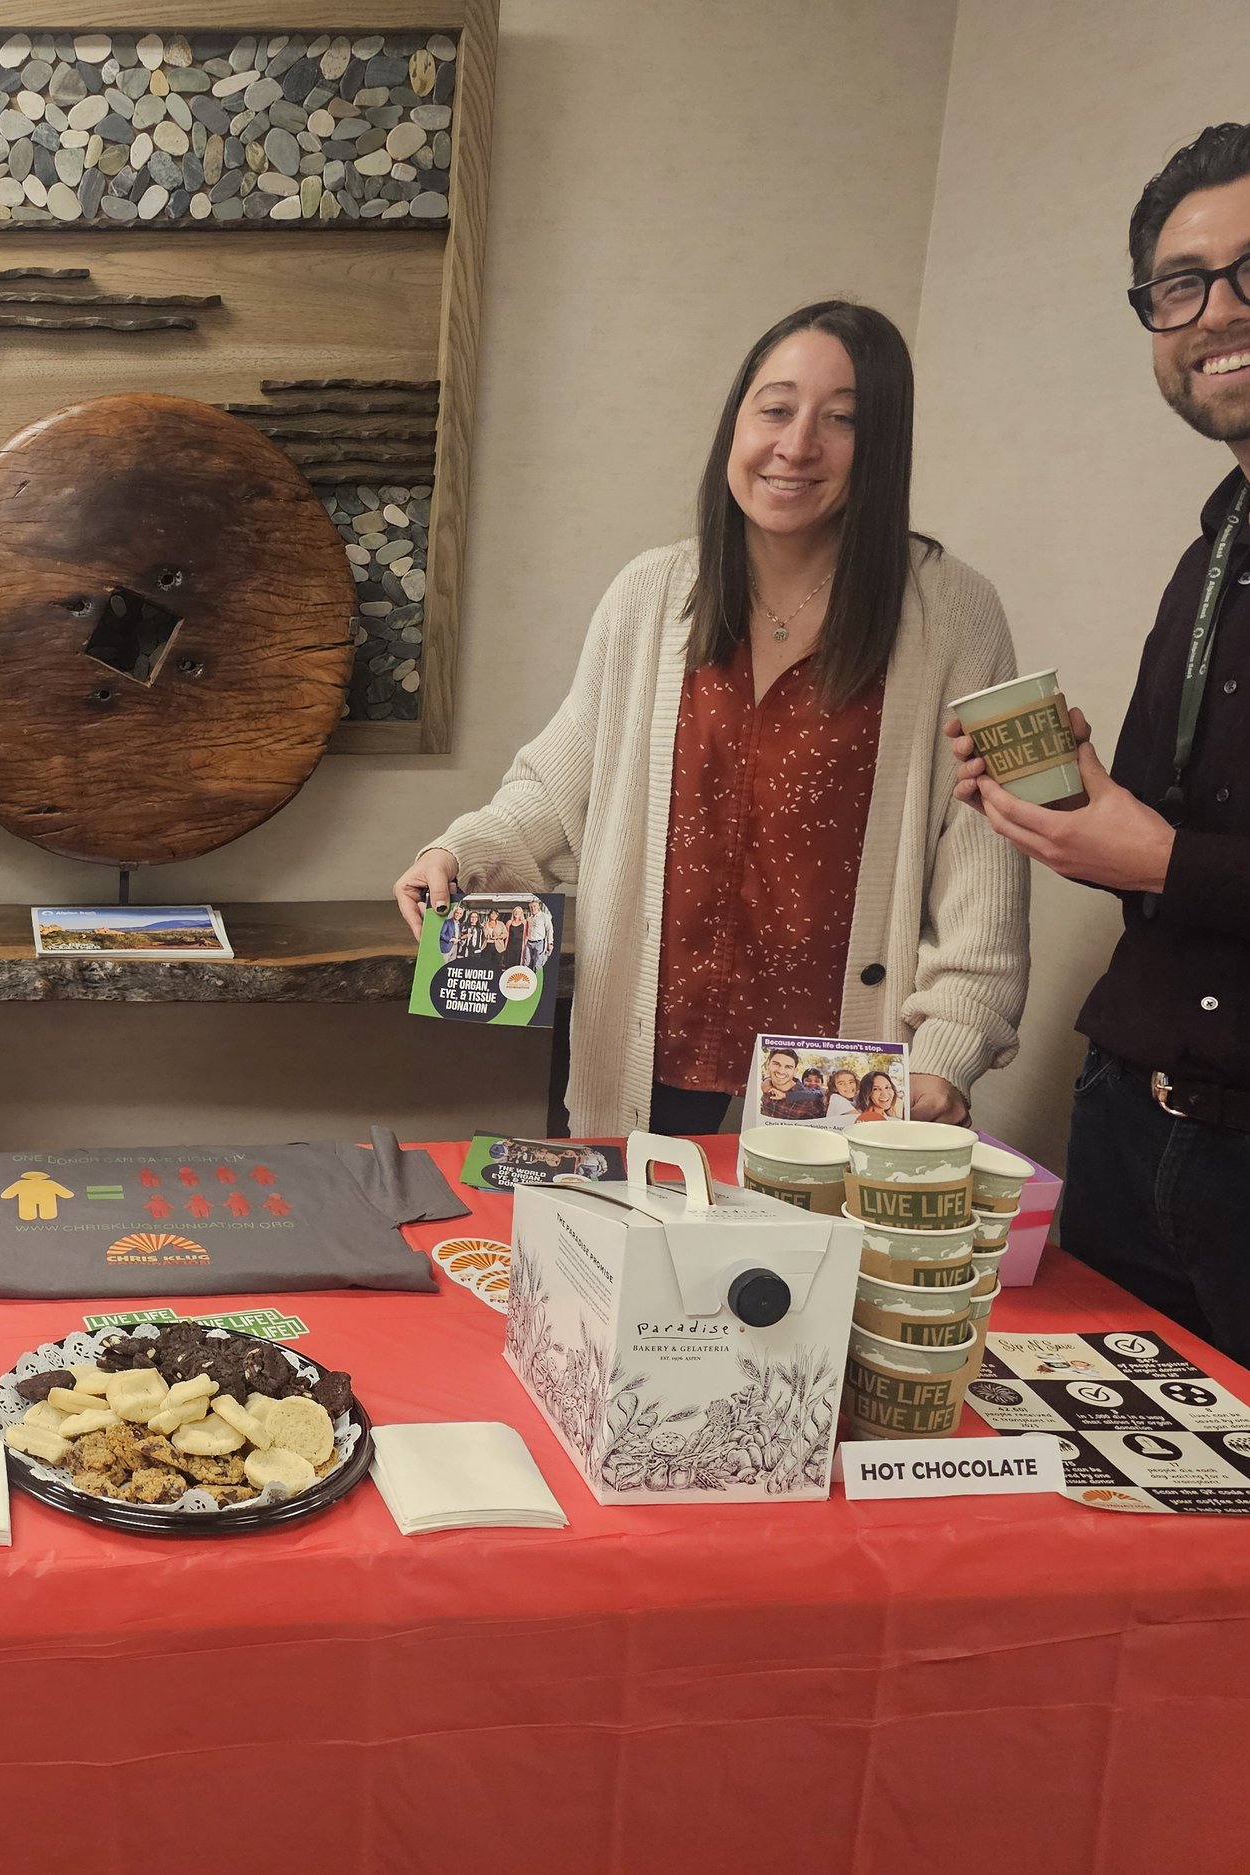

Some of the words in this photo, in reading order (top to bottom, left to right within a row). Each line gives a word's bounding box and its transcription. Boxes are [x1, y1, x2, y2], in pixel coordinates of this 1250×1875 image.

[972, 723, 1014, 753] LIVE
[1014, 708, 1059, 738] LIFE
[992, 742, 1039, 772] GIVE
[1040, 730, 1075, 757] LIFE
[447, 967, 463, 978] THE
[465, 969, 494, 980] WORLD
[447, 978, 459, 988] OF
[440, 988, 458, 1000] EYE,
[460, 991, 467, 1000] &
[468, 991, 497, 1003] TISSUE
[446, 1000, 488, 1013] DONATION
[764, 1039, 795, 1047] Because
[806, 1041, 821, 1049] you,
[835, 1043, 863, 1051] doesn't
[864, 1044, 883, 1052] stop.
[12, 1154, 43, 1162] ONE
[224, 1153, 246, 1163] LIV
[498, 1164, 514, 1172] THE
[516, 1167, 547, 1178] WORLD
[863, 1189, 913, 1217] LIVE
[921, 1192, 965, 1218] LIFE
[556, 1212, 566, 1229] THE
[566, 1224, 590, 1257] PARADISE
[590, 1252, 614, 1284] PROMISE
[90, 1315, 134, 1329] LIVE
[135, 1310, 174, 1322] LIFE
[228, 1312, 270, 1327] LIFE
[253, 1324, 289, 1340] LIFE
[637, 1320, 729, 1335] Paradise
[998, 1339, 1024, 1352] Sip
[1042, 1340, 1076, 1352] Save
[849, 1361, 891, 1399] LIVE
[897, 1383, 948, 1405] LIFE
[857, 1395, 907, 1430] GIVE
[913, 1407, 954, 1431] LIFE
[861, 1462, 905, 1480] HOT
[912, 1459, 1038, 1479] CHOCOLATE
